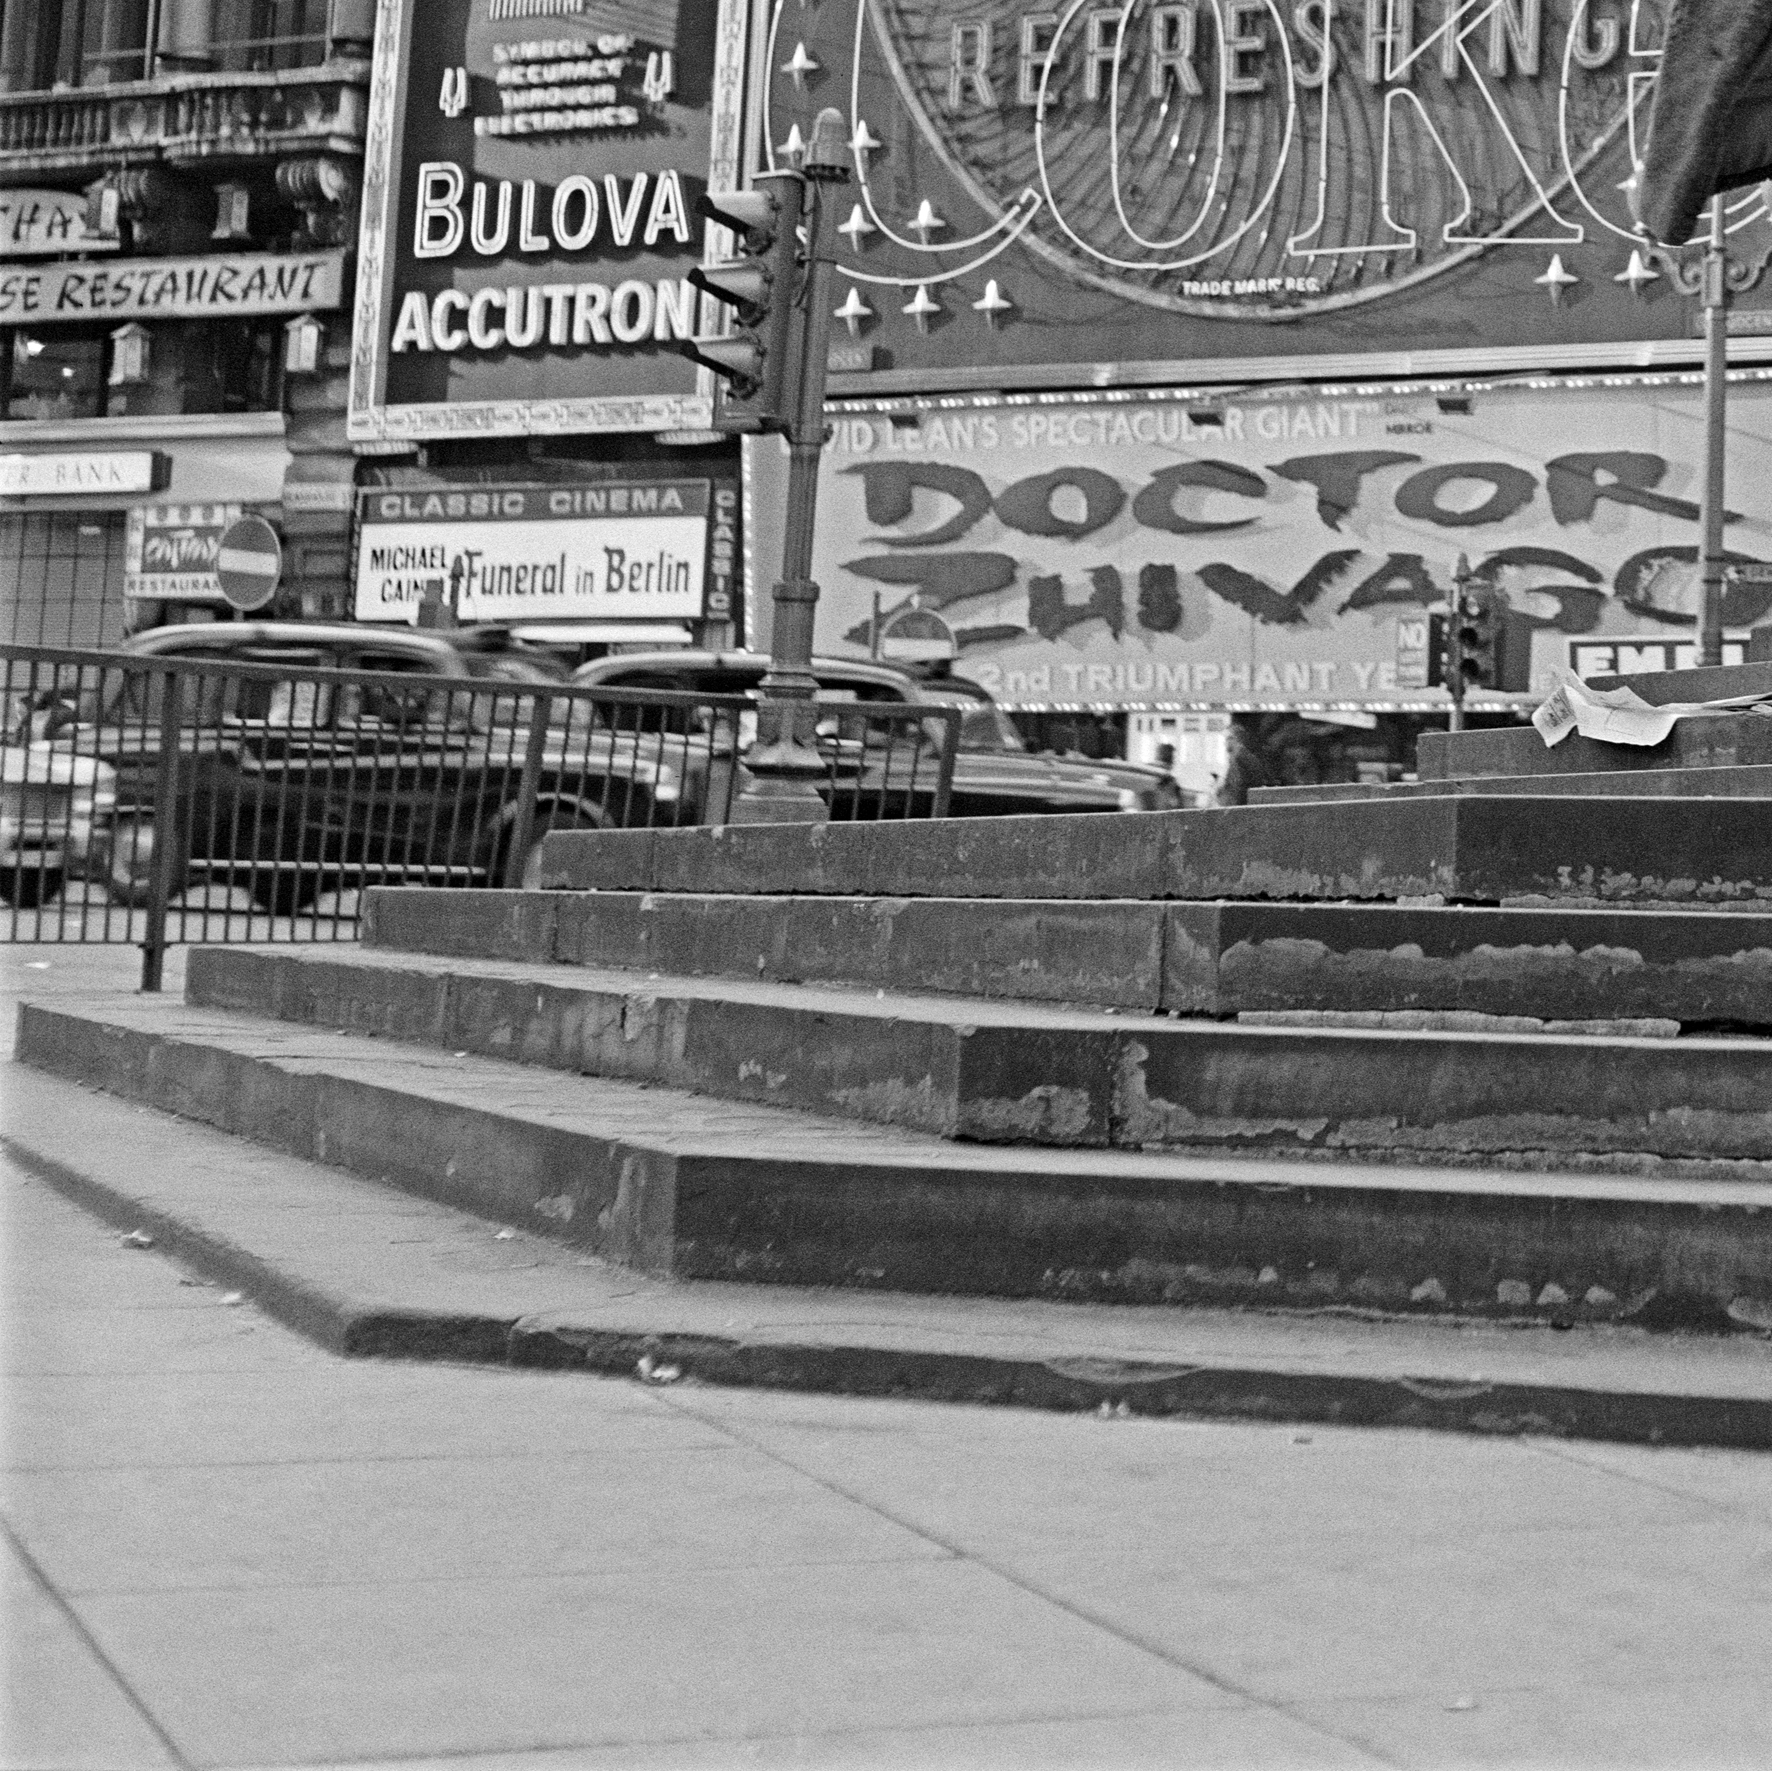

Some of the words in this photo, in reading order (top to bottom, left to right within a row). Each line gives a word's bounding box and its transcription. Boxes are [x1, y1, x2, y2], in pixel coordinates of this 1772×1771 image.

[413, 161, 690, 258] BULOVA
[56, 259, 329, 310] RESTAURANT
[1181, 279, 1233, 296] TRADE
[1234, 278, 1283, 294] MARK
[391, 278, 696, 353] ACCUTRON
[1012, 407, 1244, 446] SPECTACULAR
[380, 491, 526, 518] CLASSIC
[548, 488, 685, 514] CINEMA
[837, 450, 1745, 547] DOCTOR
[370, 545, 448, 572] MICHAEL
[464, 546, 566, 599] Funeral
[575, 564, 594, 595] in
[603, 545, 690, 594] Berlin
[987, 664, 1050, 695] 2nd
[1061, 661, 1336, 694] TRIUMPHANT
